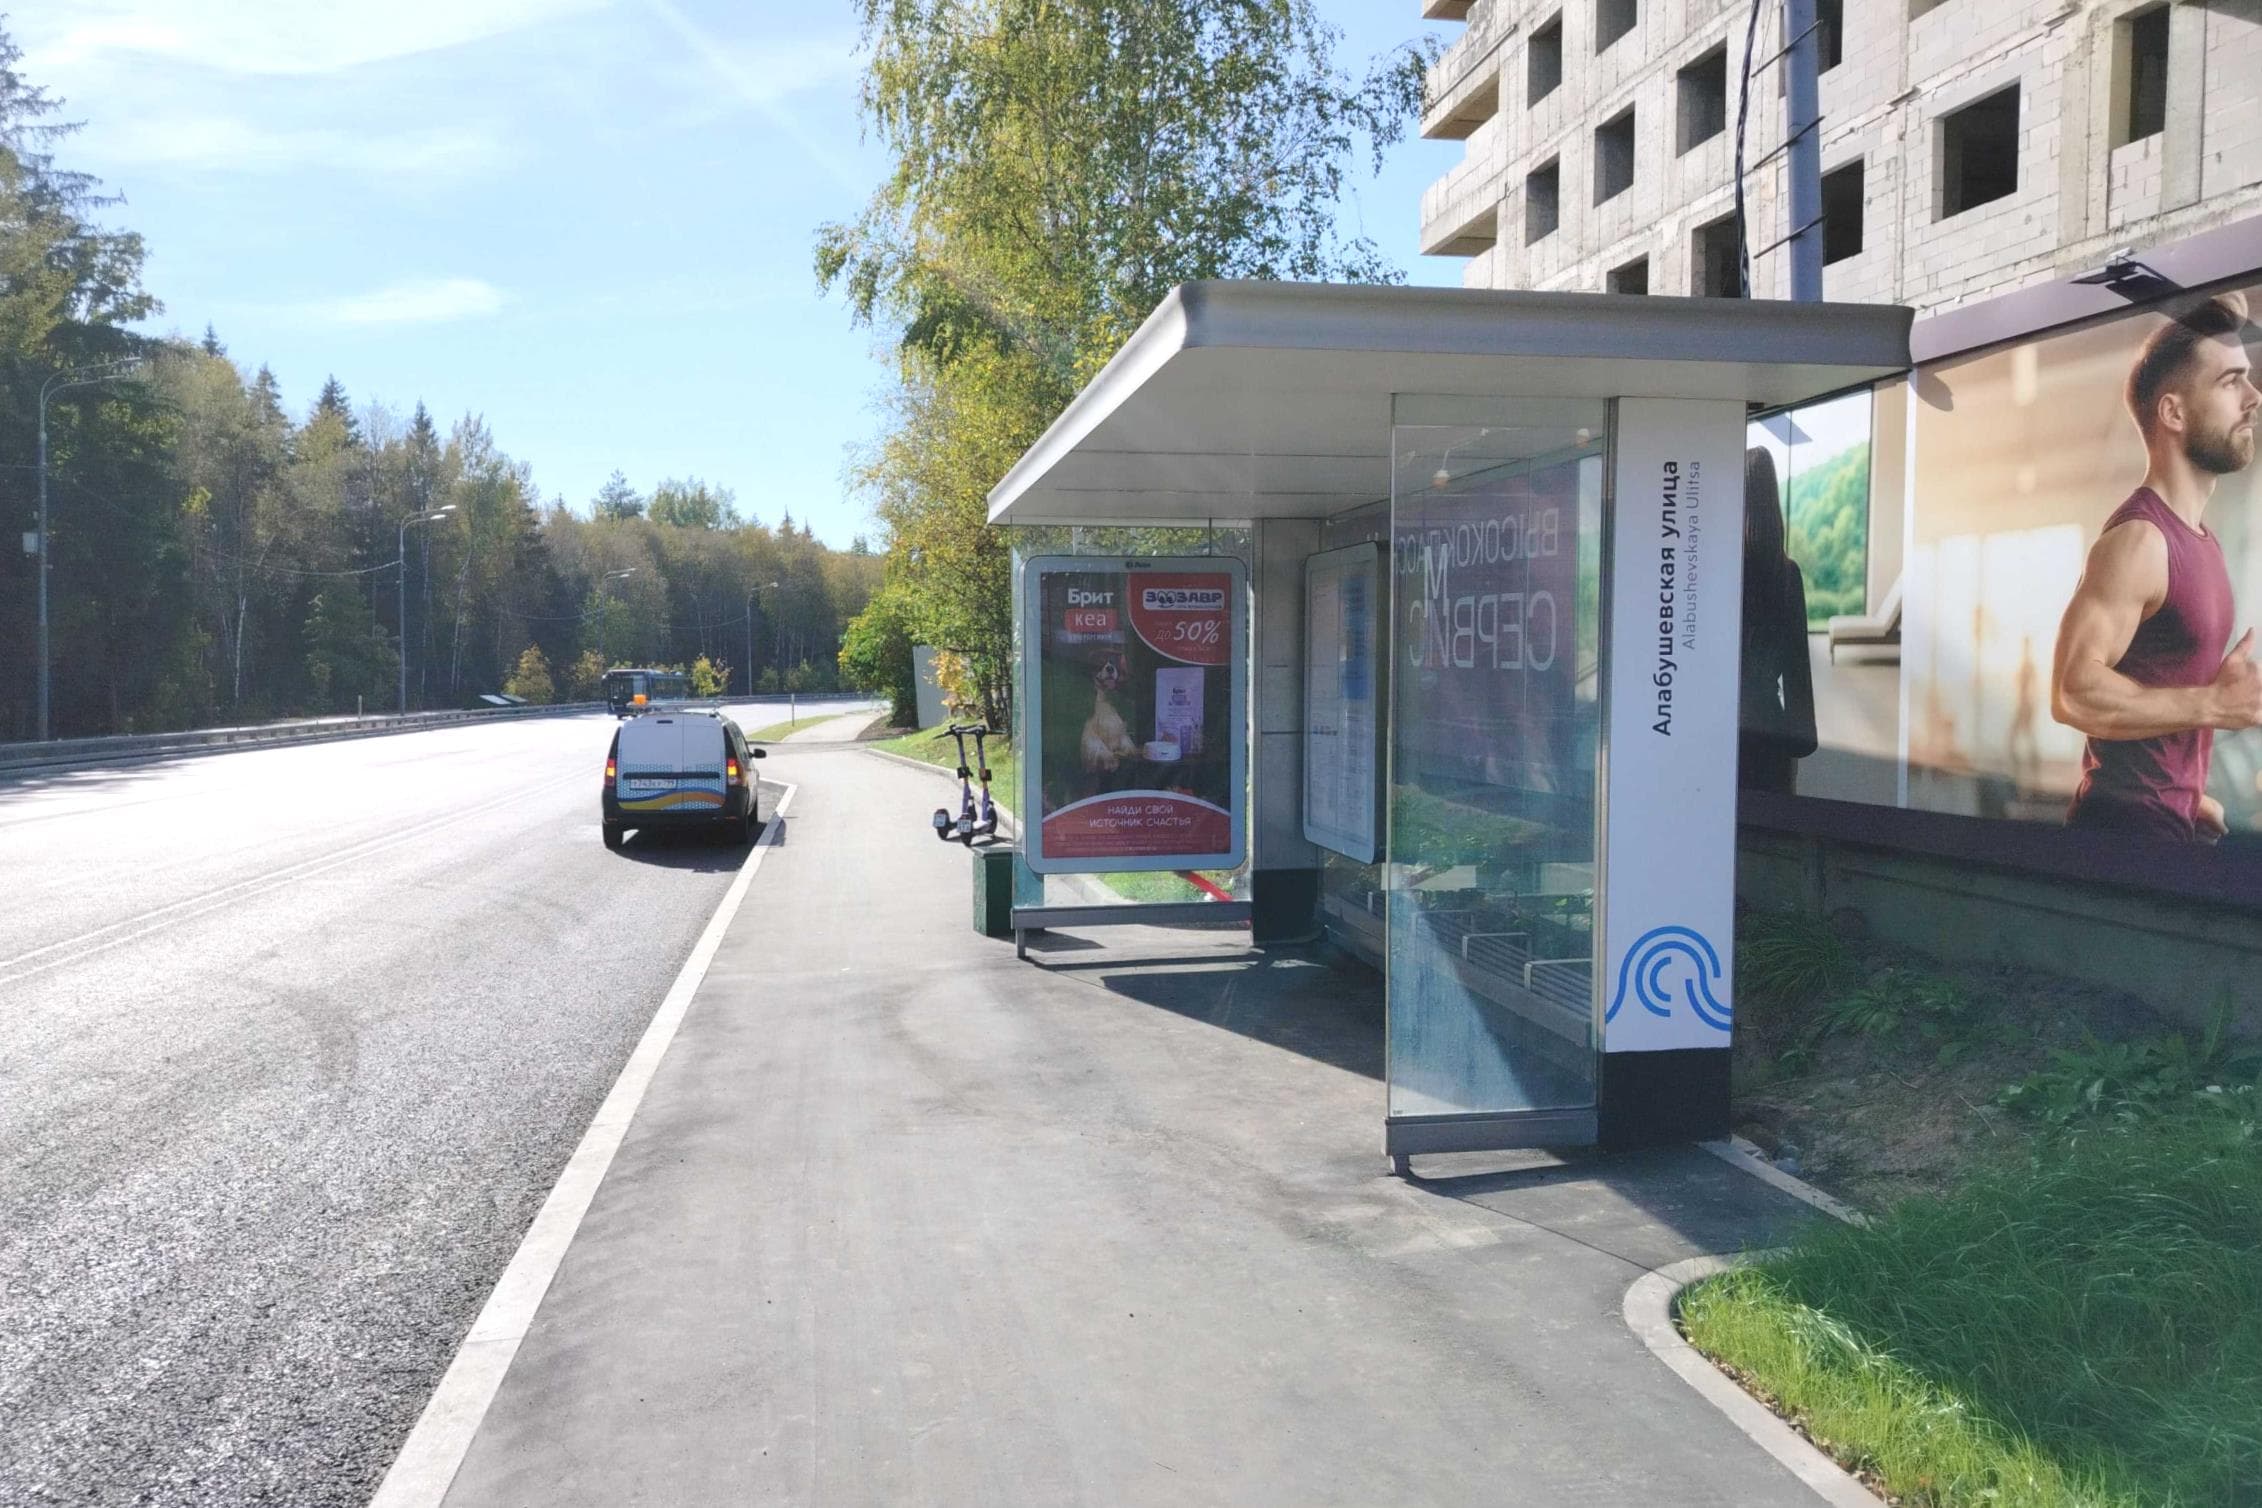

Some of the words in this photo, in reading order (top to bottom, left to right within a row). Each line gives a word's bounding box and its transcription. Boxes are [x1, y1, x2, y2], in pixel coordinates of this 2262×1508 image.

[1685, 460, 1701, 509] Ulitsa
[1661, 460, 1681, 538] улица
[1682, 514, 1701, 650] Alabushevskaya
[1067, 588, 1114, 607] Брит
[1075, 613, 1107, 626] кеа
[1173, 619, 1222, 644] 50%
[1652, 546, 1677, 737] Алабушевская
[1107, 804, 1142, 815] НАЙДИ
[1144, 803, 1174, 815] СВОЙ
[1089, 818, 1143, 828] ИСТОЧНИК
[1146, 816, 1192, 828] СЧАСТЬЯ
